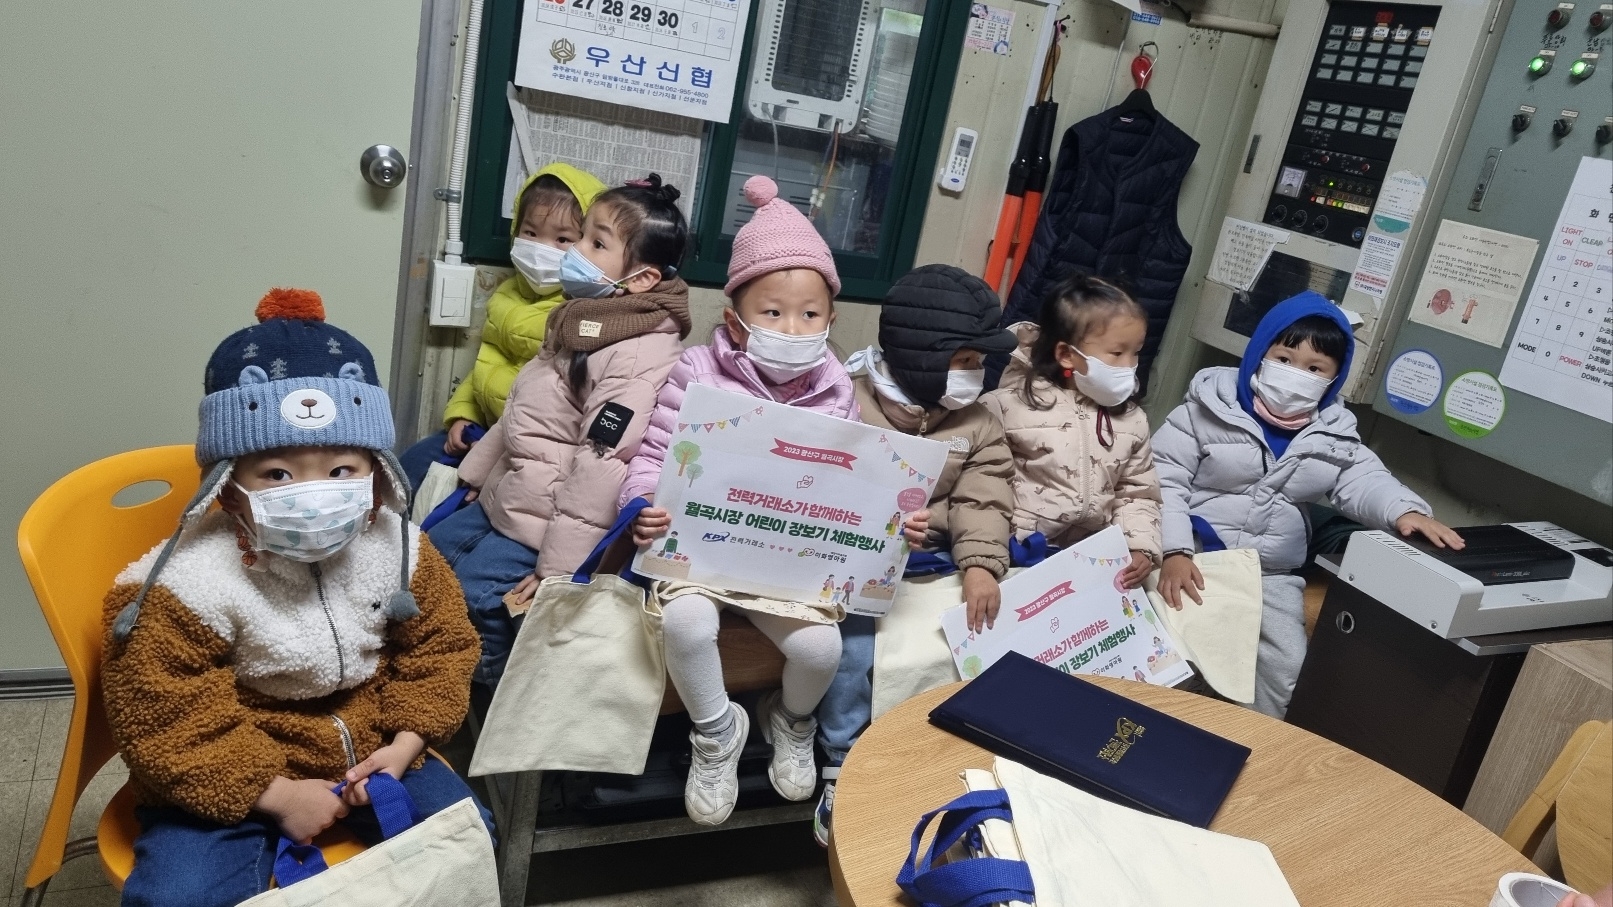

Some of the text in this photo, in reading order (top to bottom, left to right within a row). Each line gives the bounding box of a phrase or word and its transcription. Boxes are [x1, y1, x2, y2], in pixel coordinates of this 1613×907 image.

[601, 0, 624, 17] 28
[629, 4, 652, 23] 29
[657, 10, 679, 29] 30
[691, 21, 698, 34] 1
[717, 27, 726, 40] 2
[1561, 226, 1583, 236] LIGHT
[1562, 238, 1574, 246] ON
[1574, 259, 1593, 268] STOP
[1517, 342, 1583, 367] MODE 0 POWER
[1580, 372, 1602, 384] DOWN
[783, 446, 845, 463] 2023 광산구 월곡시장
[684, 501, 886, 554] 월곡시장 어린이 장보기 체험행사
[702, 532, 765, 549] KPX 전력거래소
[1069, 644, 1099, 671] 장보기
[1098, 623, 1136, 654] 체험행사
